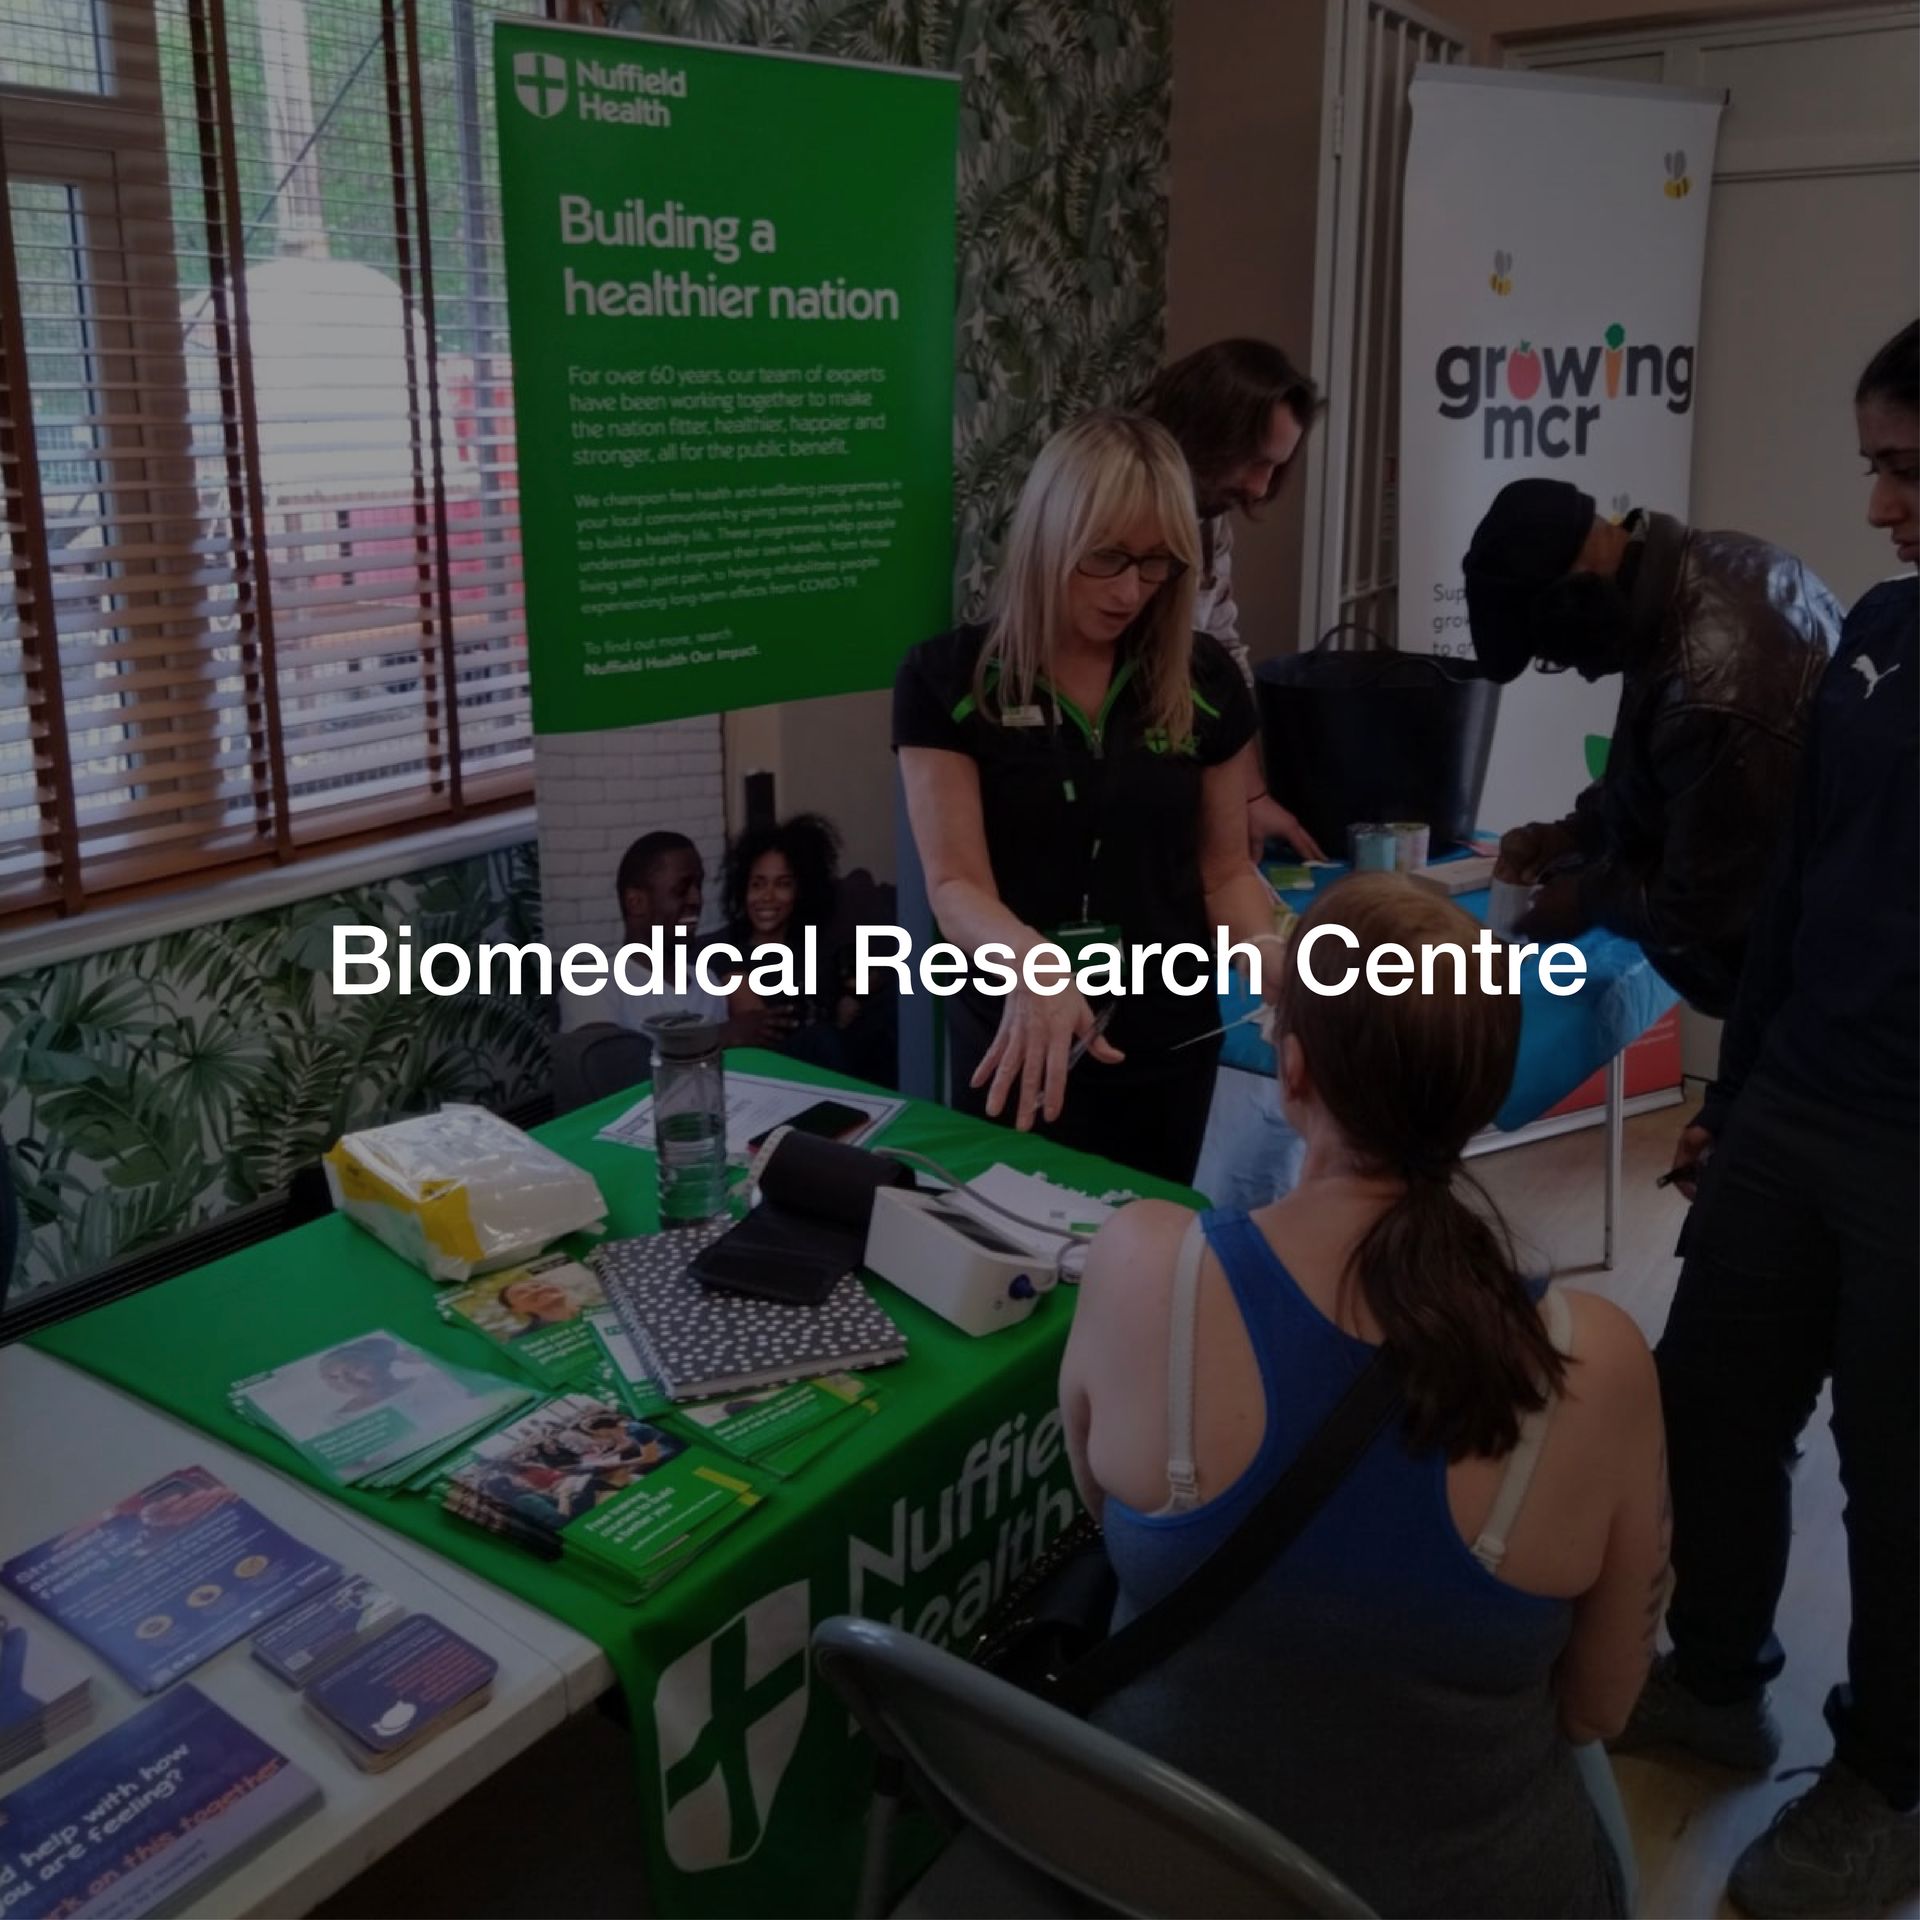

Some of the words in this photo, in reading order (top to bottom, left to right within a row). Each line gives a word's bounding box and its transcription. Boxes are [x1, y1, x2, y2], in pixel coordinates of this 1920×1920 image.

[576, 58, 687, 98] Nuffield
[579, 93, 671, 128] Health
[559, 195, 741, 264] Building
[749, 218, 777, 254] a
[564, 267, 760, 319] healthier
[769, 277, 899, 321] nation
[568, 366, 600, 386] For
[605, 370, 648, 385] over
[650, 365, 676, 385] 60
[678, 369, 725, 388] years,
[727, 369, 756, 384] our
[759, 368, 801, 384] team
[805, 364, 823, 384] of
[825, 367, 887, 387] experts
[1436, 323, 1695, 419] growing
[569, 393, 616, 412] have
[620, 392, 667, 411] been
[669, 392, 736, 414] working
[737, 391, 804, 414] together
[808, 392, 827, 408] to
[829, 390, 873, 408] make
[571, 420, 606, 439] the
[607, 418, 666, 438] nation
[789, 415, 852, 436] happier
[854, 413, 887, 431] and
[1483, 400, 1602, 461] mcr
[657, 443, 679, 463] all
[680, 442, 705, 461] for
[707, 442, 735, 461] the
[737, 439, 787, 462] public
[574, 494, 600, 509] We
[1432, 583, 1466, 605] Sup
[583, 641, 602, 656] To
[604, 638, 632, 654] find
[633, 636, 656, 651] out
[583, 657, 643, 676] Nuffield
[645, 650, 689, 670] Health
[690, 648, 715, 665] Our
[848, 1407, 1067, 1620] Nuffie
[19, 1824, 79, 1868] help
[82, 1782, 139, 1824] with
[138, 1743, 190, 1781] how
[39, 1842, 88, 1881] are
[87, 1768, 184, 1843] feeling?
